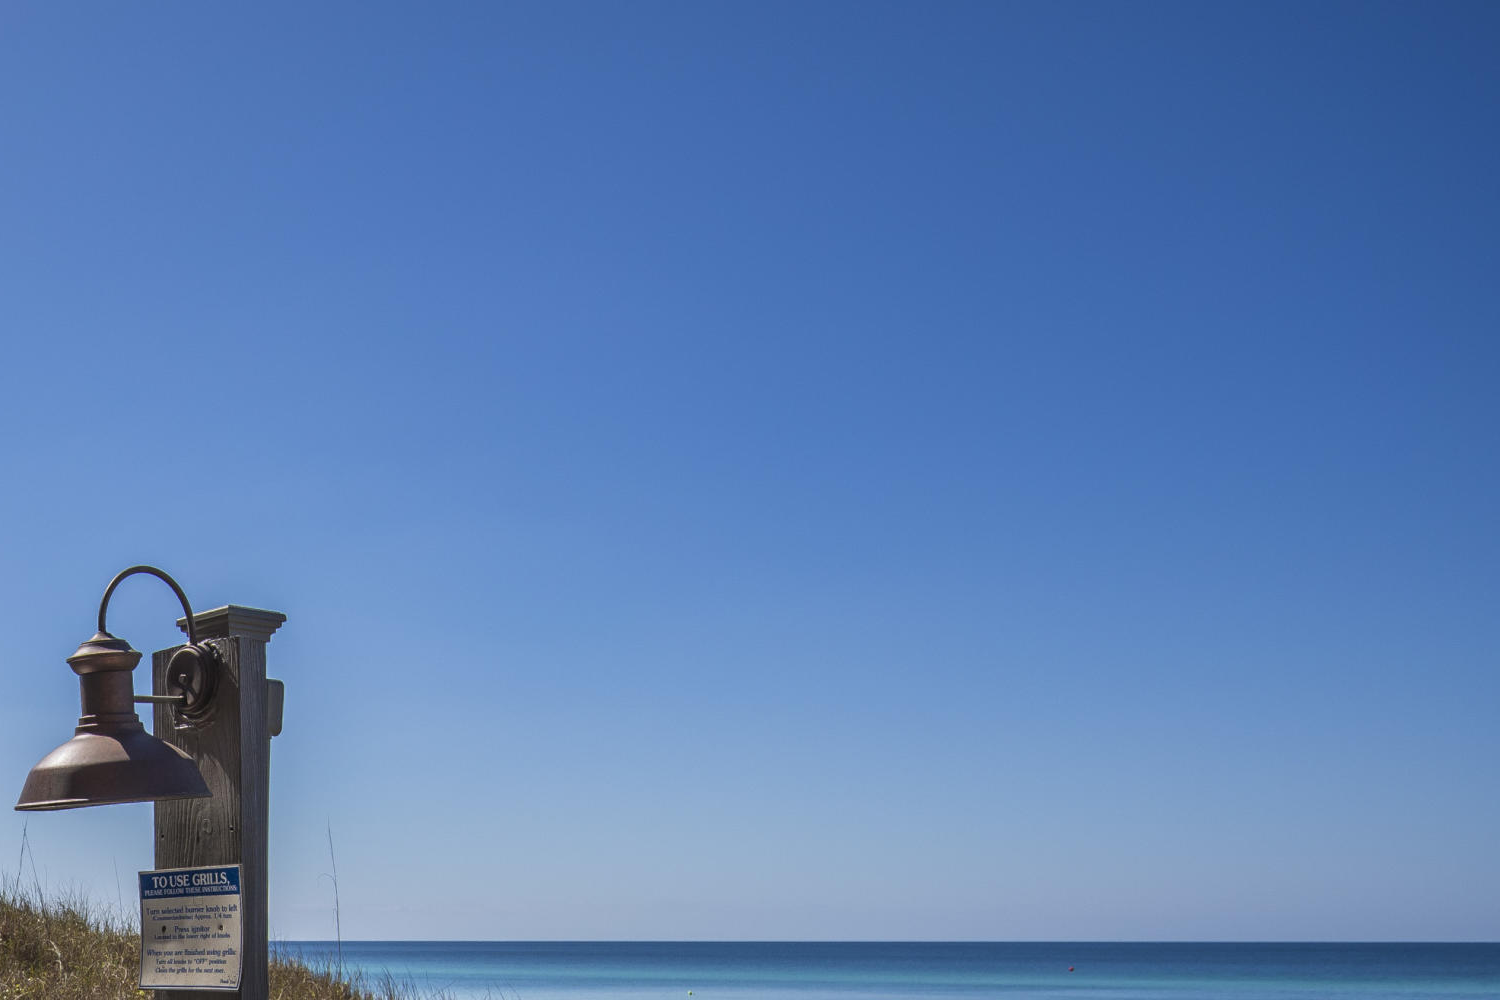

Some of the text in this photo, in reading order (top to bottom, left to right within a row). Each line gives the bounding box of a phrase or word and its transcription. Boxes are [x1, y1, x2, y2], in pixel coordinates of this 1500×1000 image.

[152, 872, 230, 888] TO USE GRILLS,
[185, 905, 204, 913] burner
